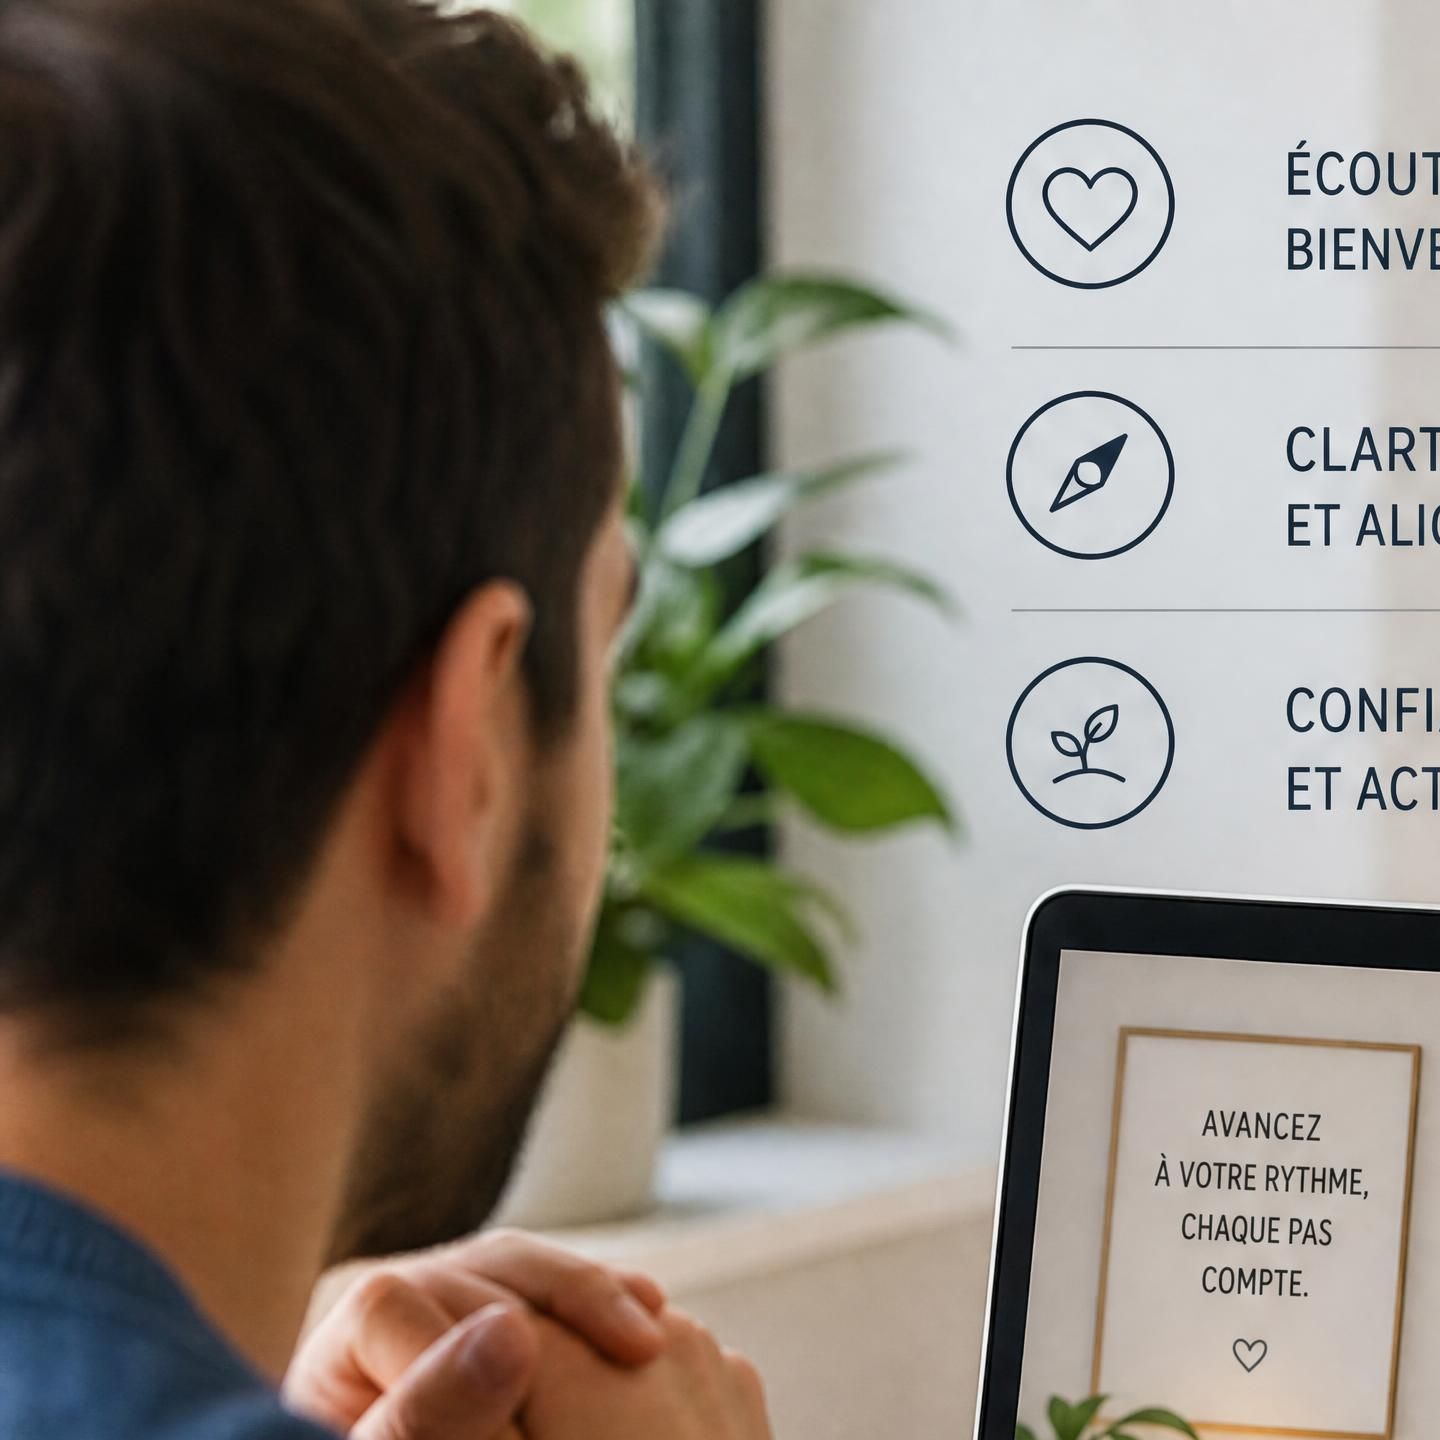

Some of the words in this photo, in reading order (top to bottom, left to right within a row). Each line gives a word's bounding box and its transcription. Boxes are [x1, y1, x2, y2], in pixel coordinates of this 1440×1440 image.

[1201, 1109, 1322, 1142] AVANCEZ
[1154, 1152, 1171, 1187] À
[1179, 1160, 1257, 1191] VOTRE
[1265, 1164, 1369, 1200] RYTHME,
[1181, 1212, 1281, 1246] CHAQUE
[1288, 1217, 1332, 1247] PAS
[1201, 1265, 1308, 1297] COMPTE.
